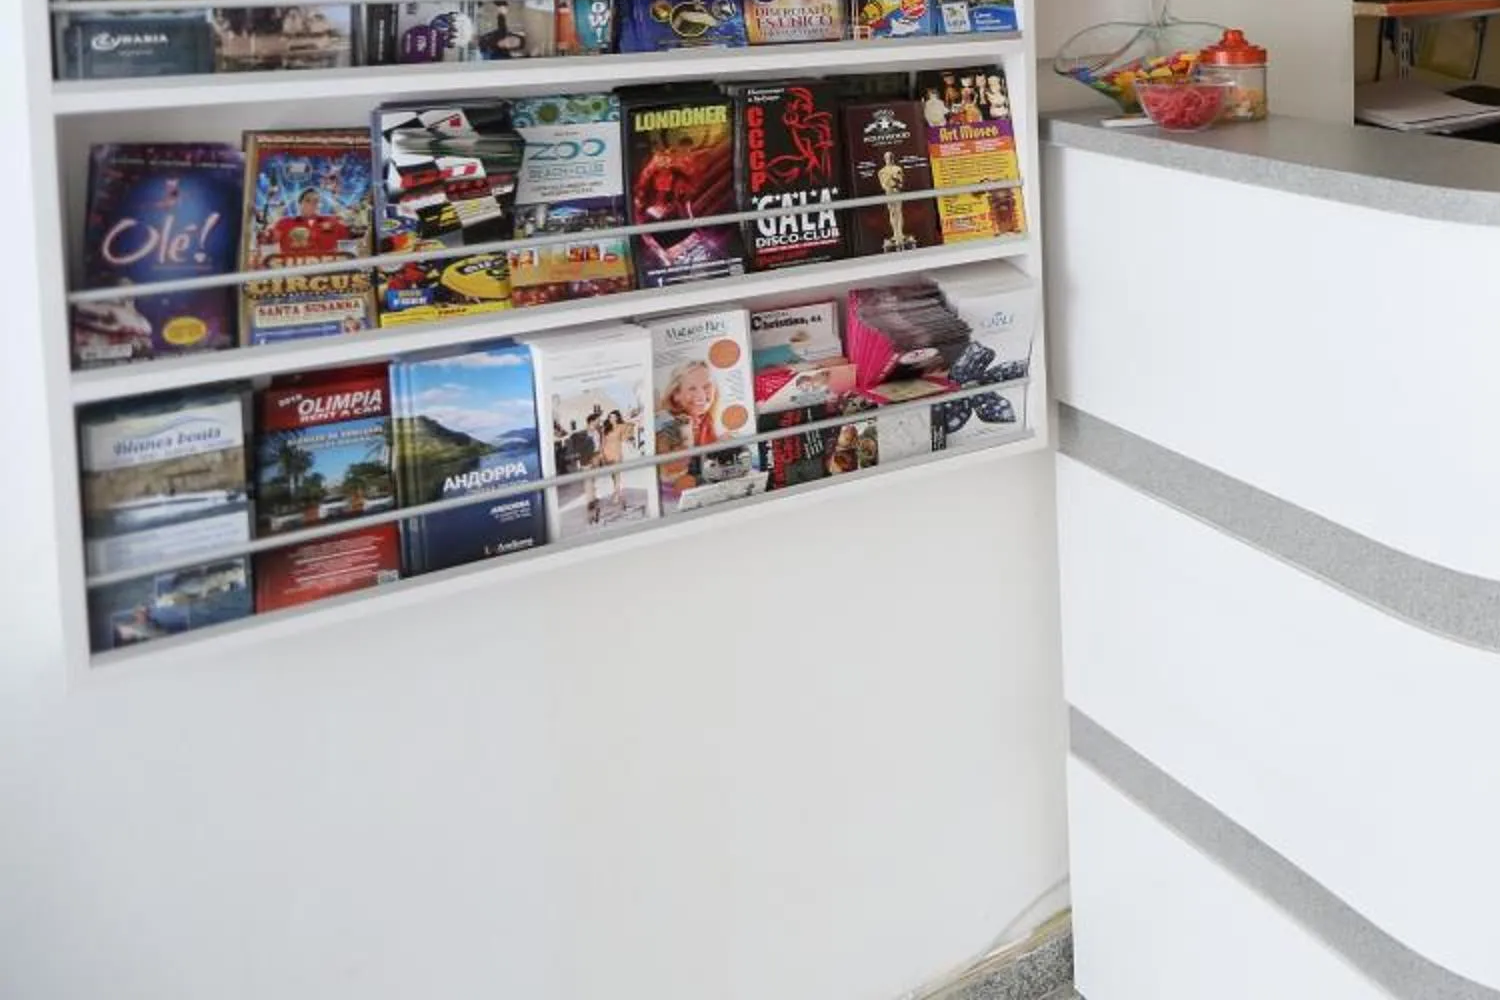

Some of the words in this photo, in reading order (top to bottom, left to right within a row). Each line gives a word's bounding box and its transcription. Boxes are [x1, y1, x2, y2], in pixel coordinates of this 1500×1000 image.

[635, 105, 728, 132] LONDONER
[524, 138, 606, 161] ZOO
[757, 188, 837, 237] GALA
[103, 213, 220, 263] Olé!
[248, 274, 369, 295] CIRCUS
[298, 389, 384, 416] OLIMPIA
[443, 462, 529, 493] АНДОРРА
